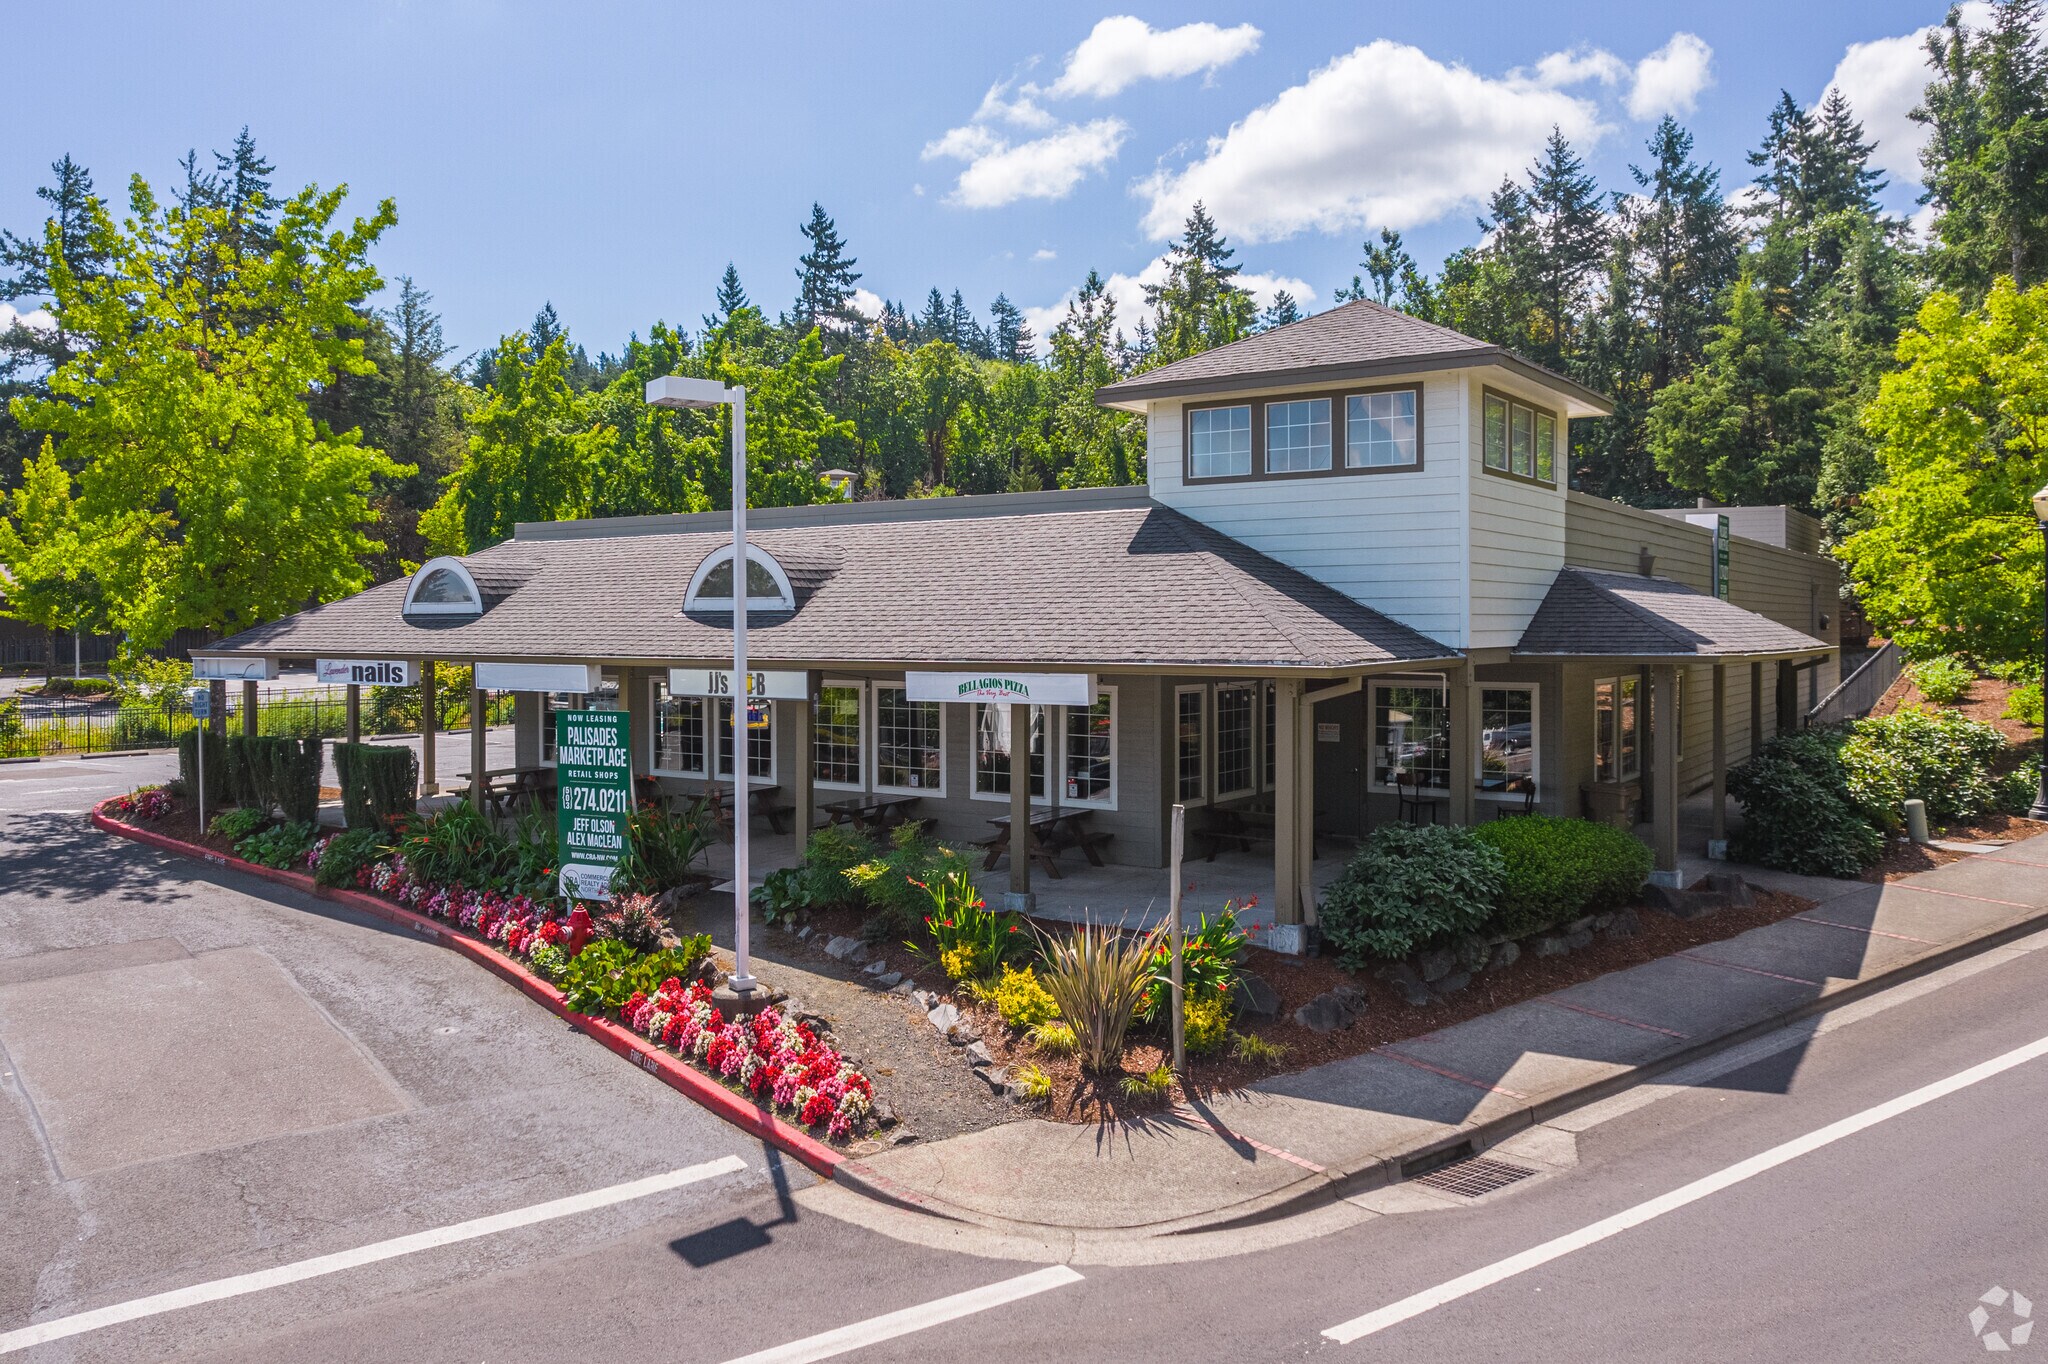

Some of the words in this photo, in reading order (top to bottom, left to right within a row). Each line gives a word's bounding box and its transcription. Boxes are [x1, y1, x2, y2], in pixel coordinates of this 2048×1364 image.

[351, 662, 404, 684] nails
[708, 671, 728, 695] JJ's
[958, 677, 1003, 696] BELLAGIOS
[1004, 679, 1029, 698] PIZZA
[567, 713, 584, 722] NOW
[586, 714, 618, 723] LEASING
[567, 726, 618, 747] PALISADES
[559, 746, 627, 767] MARKETPLACE
[568, 769, 593, 778] RETAIL
[594, 770, 619, 780] SHOPS
[573, 787, 627, 813] 274.0211
[573, 817, 590, 831] JEFF
[590, 818, 615, 834] OLSON
[567, 831, 586, 846] ALEX
[587, 833, 622, 849] MACLEAN
[630, 1049, 643, 1065] FIRE
[643, 1055, 659, 1074] LANE
